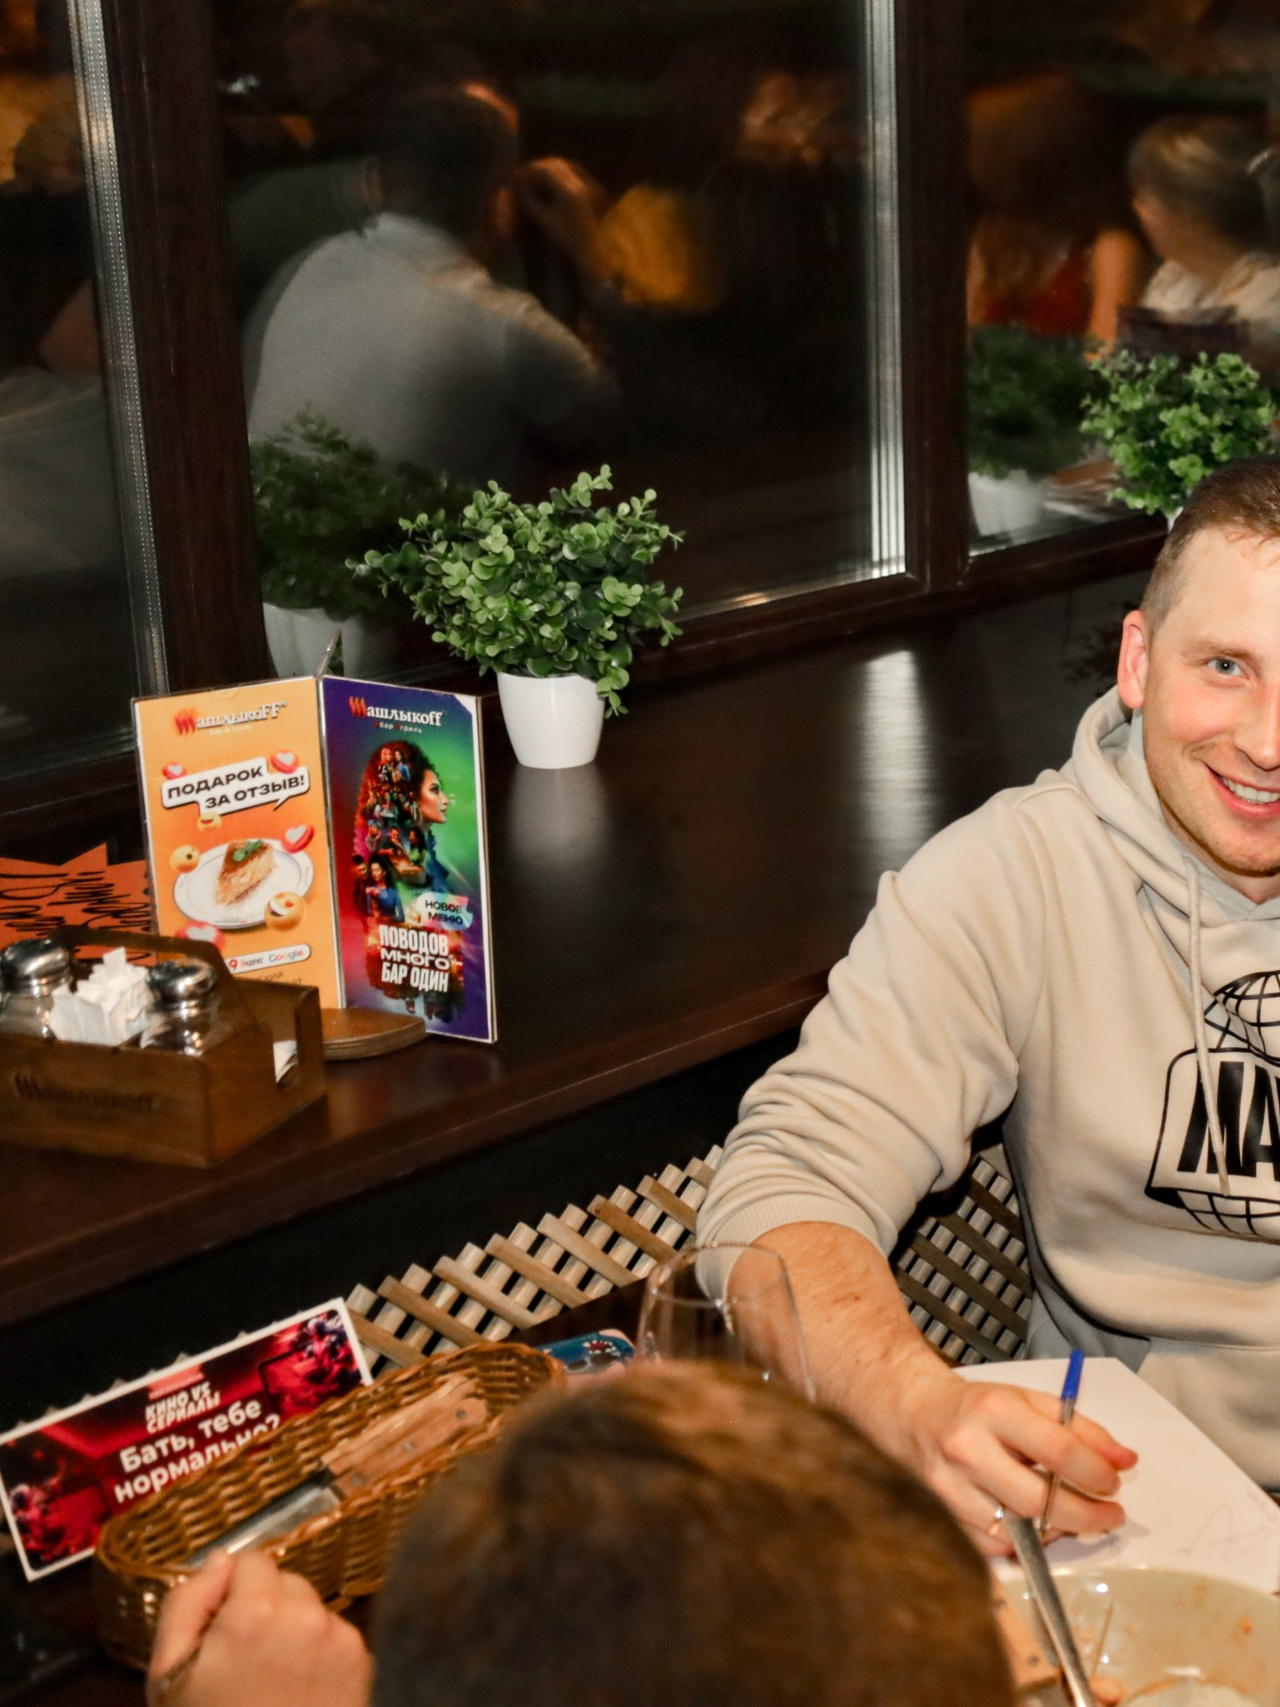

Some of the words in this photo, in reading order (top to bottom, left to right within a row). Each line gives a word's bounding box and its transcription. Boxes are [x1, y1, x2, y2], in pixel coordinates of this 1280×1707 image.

[168, 765, 263, 799] ПОДАРОК
[205, 794, 232, 809] ЗА
[233, 774, 305, 801] ОТЗЫВ!
[425, 900, 463, 914] НОВОЕ
[428, 911, 463, 925] МЕНЮ
[268, 949, 304, 963] Google
[379, 924, 449, 957] ПОВОДОВ
[380, 947, 450, 970] МНОГО
[381, 961, 409, 985] БАР
[409, 966, 449, 993] ОДИН
[145, 1390, 189, 1421] КИНО
[190, 1381, 211, 1401] VS
[146, 1390, 220, 1434] СЕРИАЛЫ
[119, 1434, 195, 1474] Бать,
[198, 1400, 262, 1438] тебе
